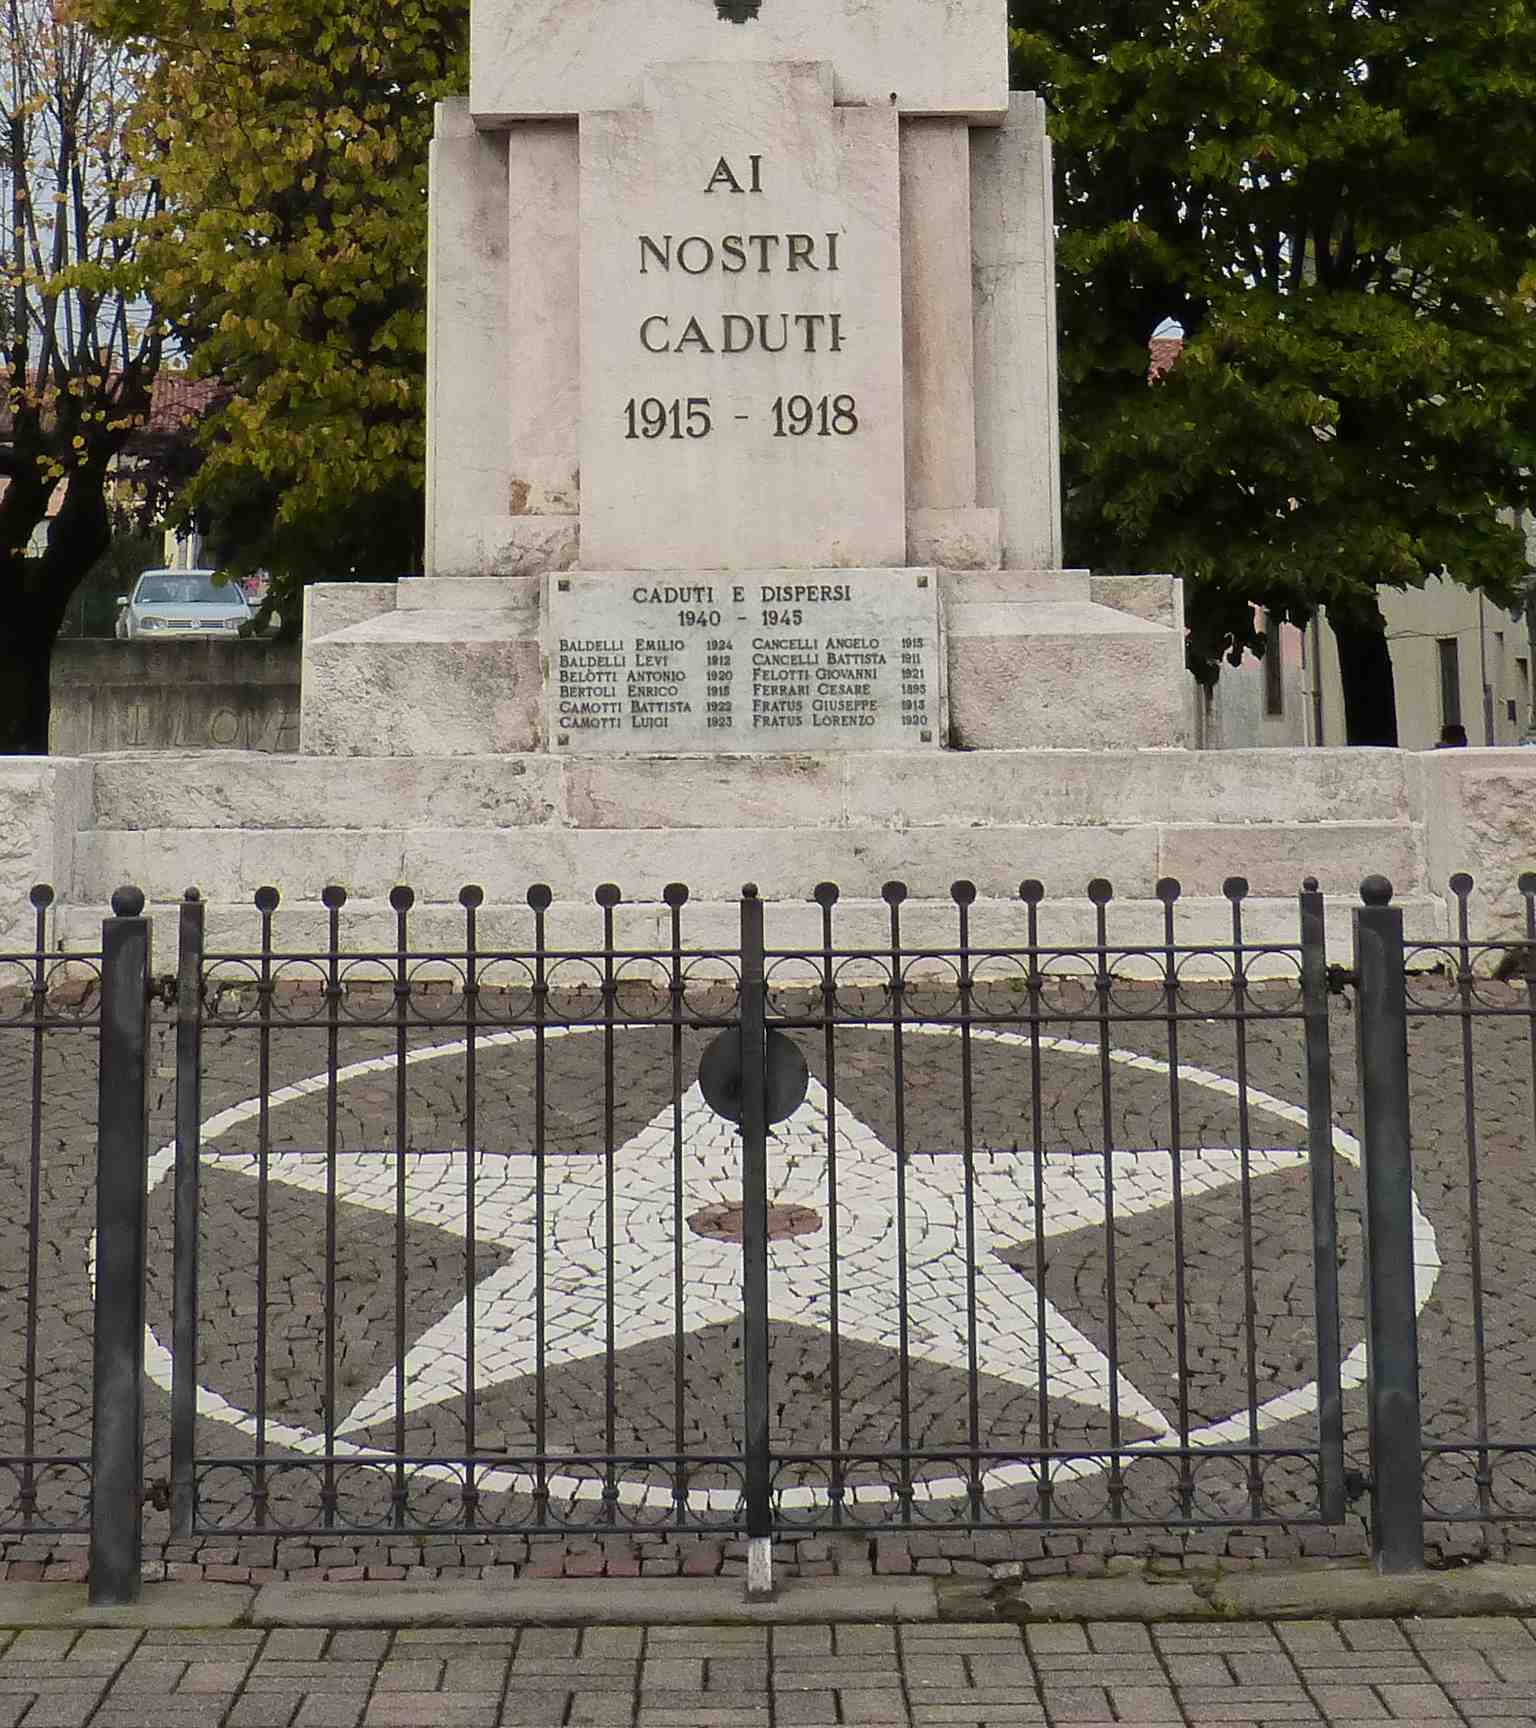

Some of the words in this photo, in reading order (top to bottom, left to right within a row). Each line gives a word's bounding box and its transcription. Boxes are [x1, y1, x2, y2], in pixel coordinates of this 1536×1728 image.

[704, 154, 763, 193] AI
[638, 232, 840, 274] NOSTRI
[639, 313, 842, 353] CADUTI
[624, 398, 712, 440] 1915
[772, 394, 858, 436] 1918
[632, 587, 714, 604] CADUTI
[733, 586, 745, 603] E
[762, 585, 851, 602] DISPERSI
[678, 611, 721, 627] 1940
[762, 610, 803, 626] 1945
[560, 640, 624, 651] BALDELLI
[635, 639, 685, 651] EMILIO
[752, 638, 818, 650] CANCELLI
[825, 638, 879, 650] ANGELO
[560, 655, 626, 668] BALDELLI
[635, 653, 668, 667] LEVI
[752, 653, 819, 665] CANCELLI
[827, 653, 886, 665] BATTISTA
[627, 670, 686, 682] ANTONIO
[815, 668, 877, 680] GIOVANNI
[560, 685, 616, 698] BERTOLI
[628, 685, 679, 697] ENRICO
[753, 683, 809, 696] FERRARI
[817, 683, 871, 695] CESARE
[631, 700, 692, 713] BATTISTA
[752, 699, 802, 712] FRATUS
[812, 699, 878, 712] GIUSEPPE
[632, 715, 669, 728] LUIGI
[752, 714, 802, 728] FRATUS
[813, 714, 876, 727] LORENZO
